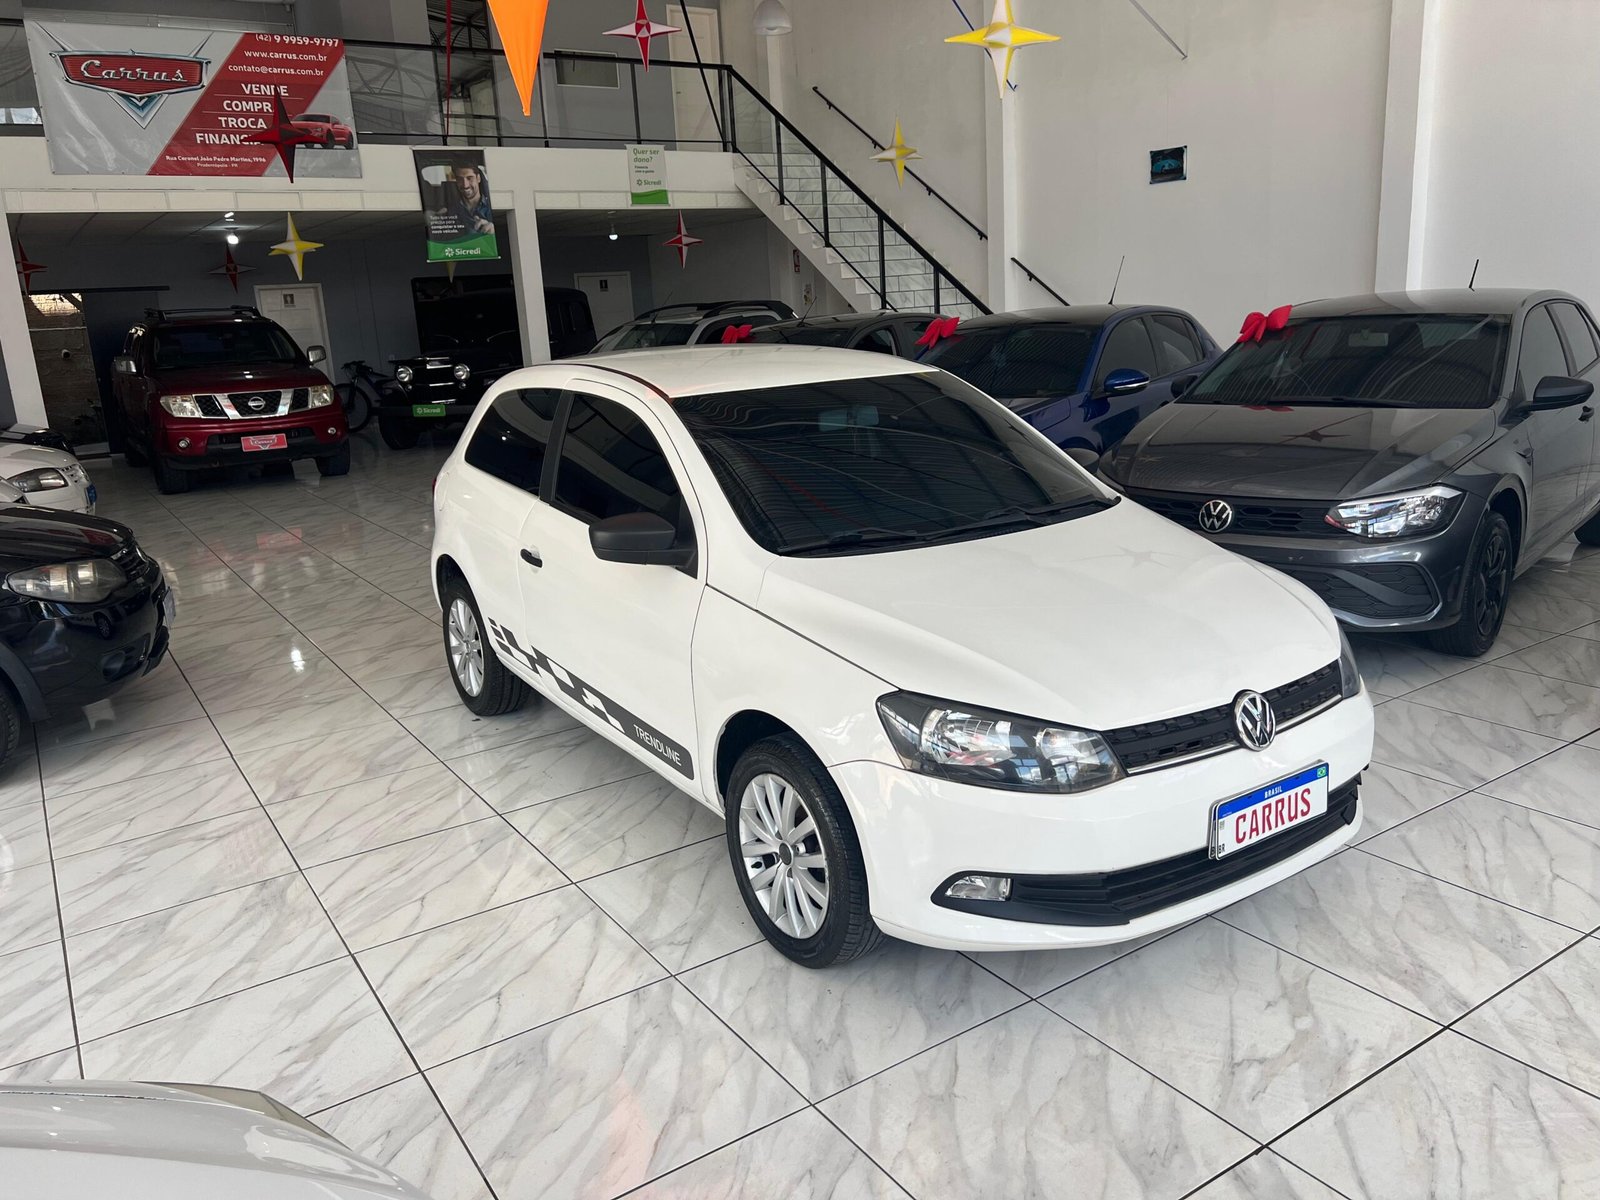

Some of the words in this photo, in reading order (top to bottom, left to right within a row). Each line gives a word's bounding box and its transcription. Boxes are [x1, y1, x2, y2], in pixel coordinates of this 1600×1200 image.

[256, 34, 272, 43] (42)
[274, 36, 281, 44] 9
[283, 36, 339, 48] 9959-9797
[244, 50, 327, 62] www.carrus.com.br
[80, 59, 187, 82] Carrus
[228, 64, 324, 76] contato@carrus.com.br
[241, 83, 289, 96] VENE
[223, 100, 275, 113] COMPR
[218, 116, 268, 129] TROCA
[633, 148, 648, 156] Quer
[455, 247, 481, 256] Sicredi
[633, 724, 682, 767] TRENDLINE
[1264, 785, 1283, 798] BRASIL
[1235, 788, 1311, 844] CARRUS
[1218, 843, 1226, 854] BR
